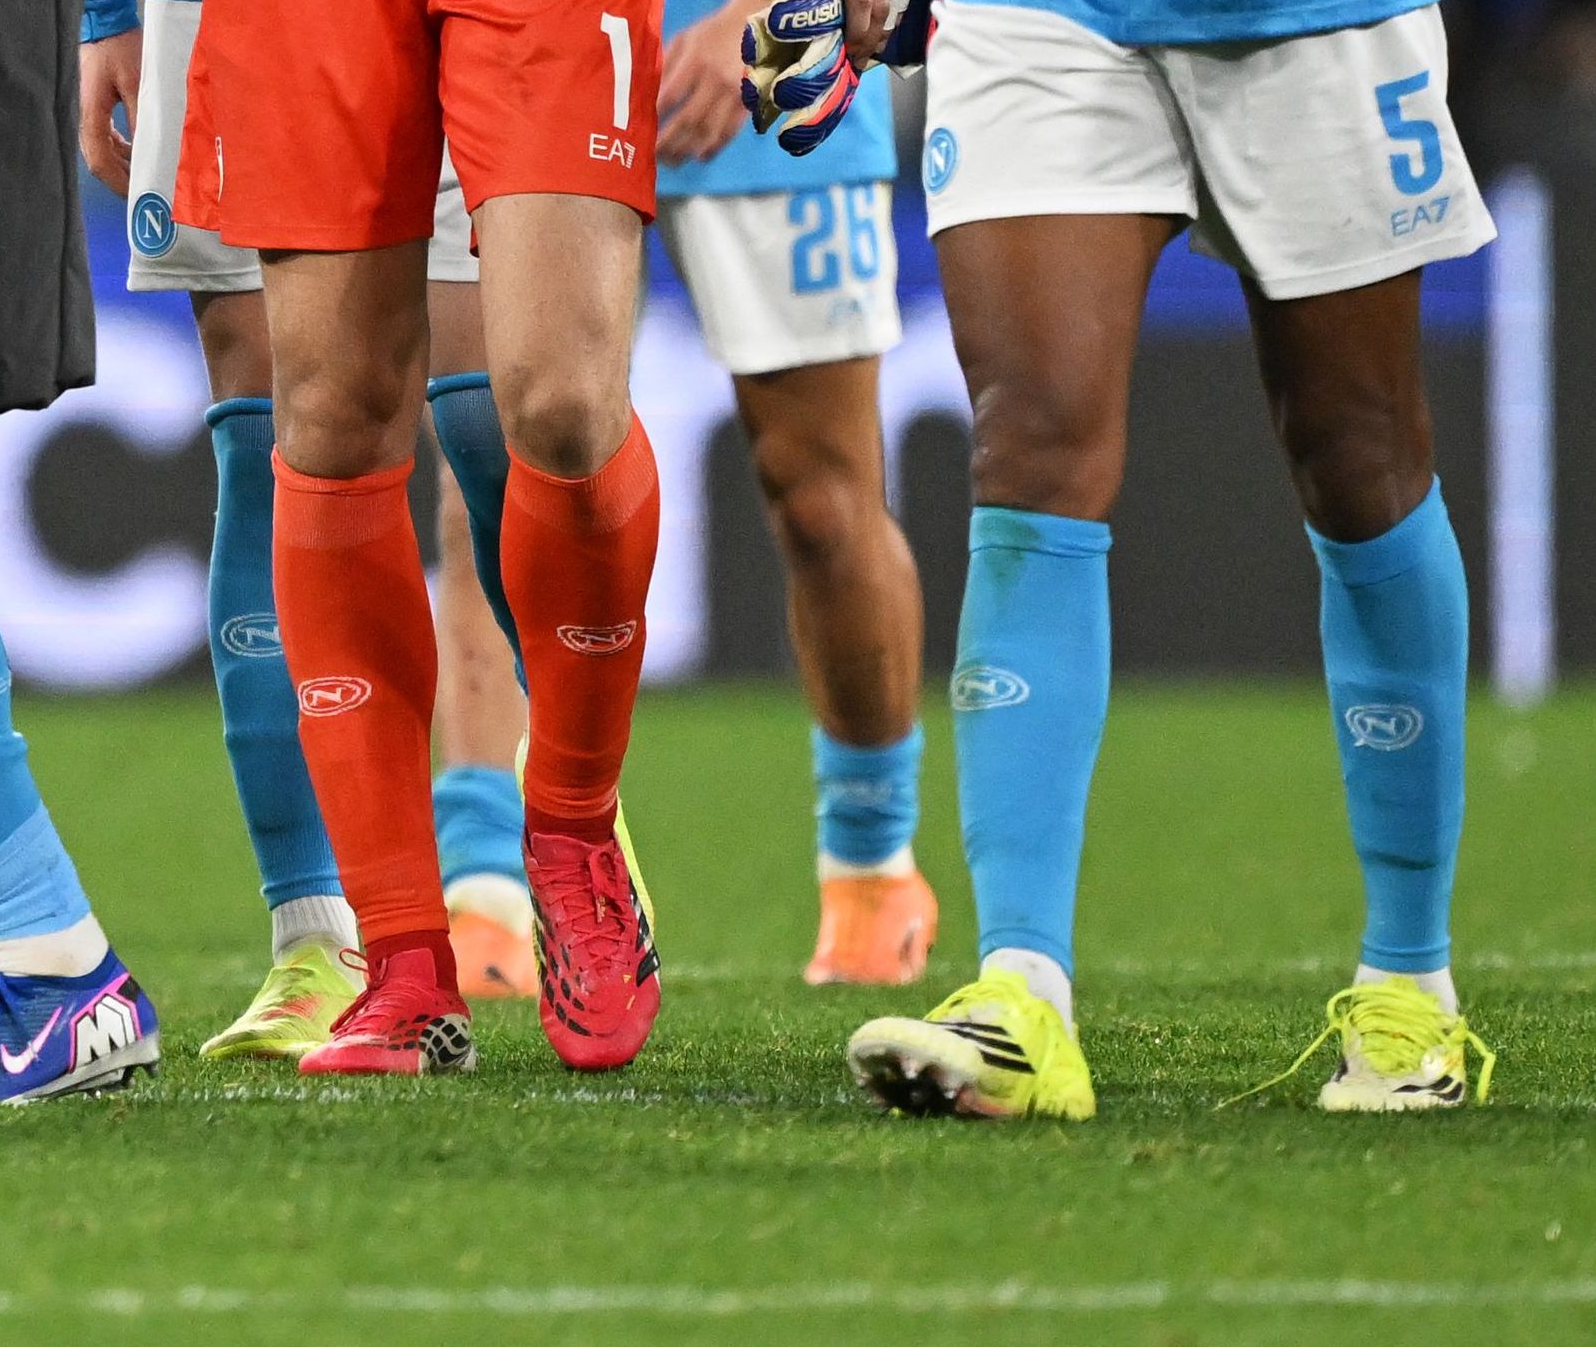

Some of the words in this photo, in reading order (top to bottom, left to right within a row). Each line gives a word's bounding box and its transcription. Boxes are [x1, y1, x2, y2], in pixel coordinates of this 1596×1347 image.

[600, 11, 634, 130] 1
[589, 133, 635, 168] EA7
[1374, 69, 1443, 197] 5
[928, 145, 950, 178] N
[142, 210, 163, 241] N
[1391, 196, 1451, 237] EA7
[789, 191, 881, 294] 26
